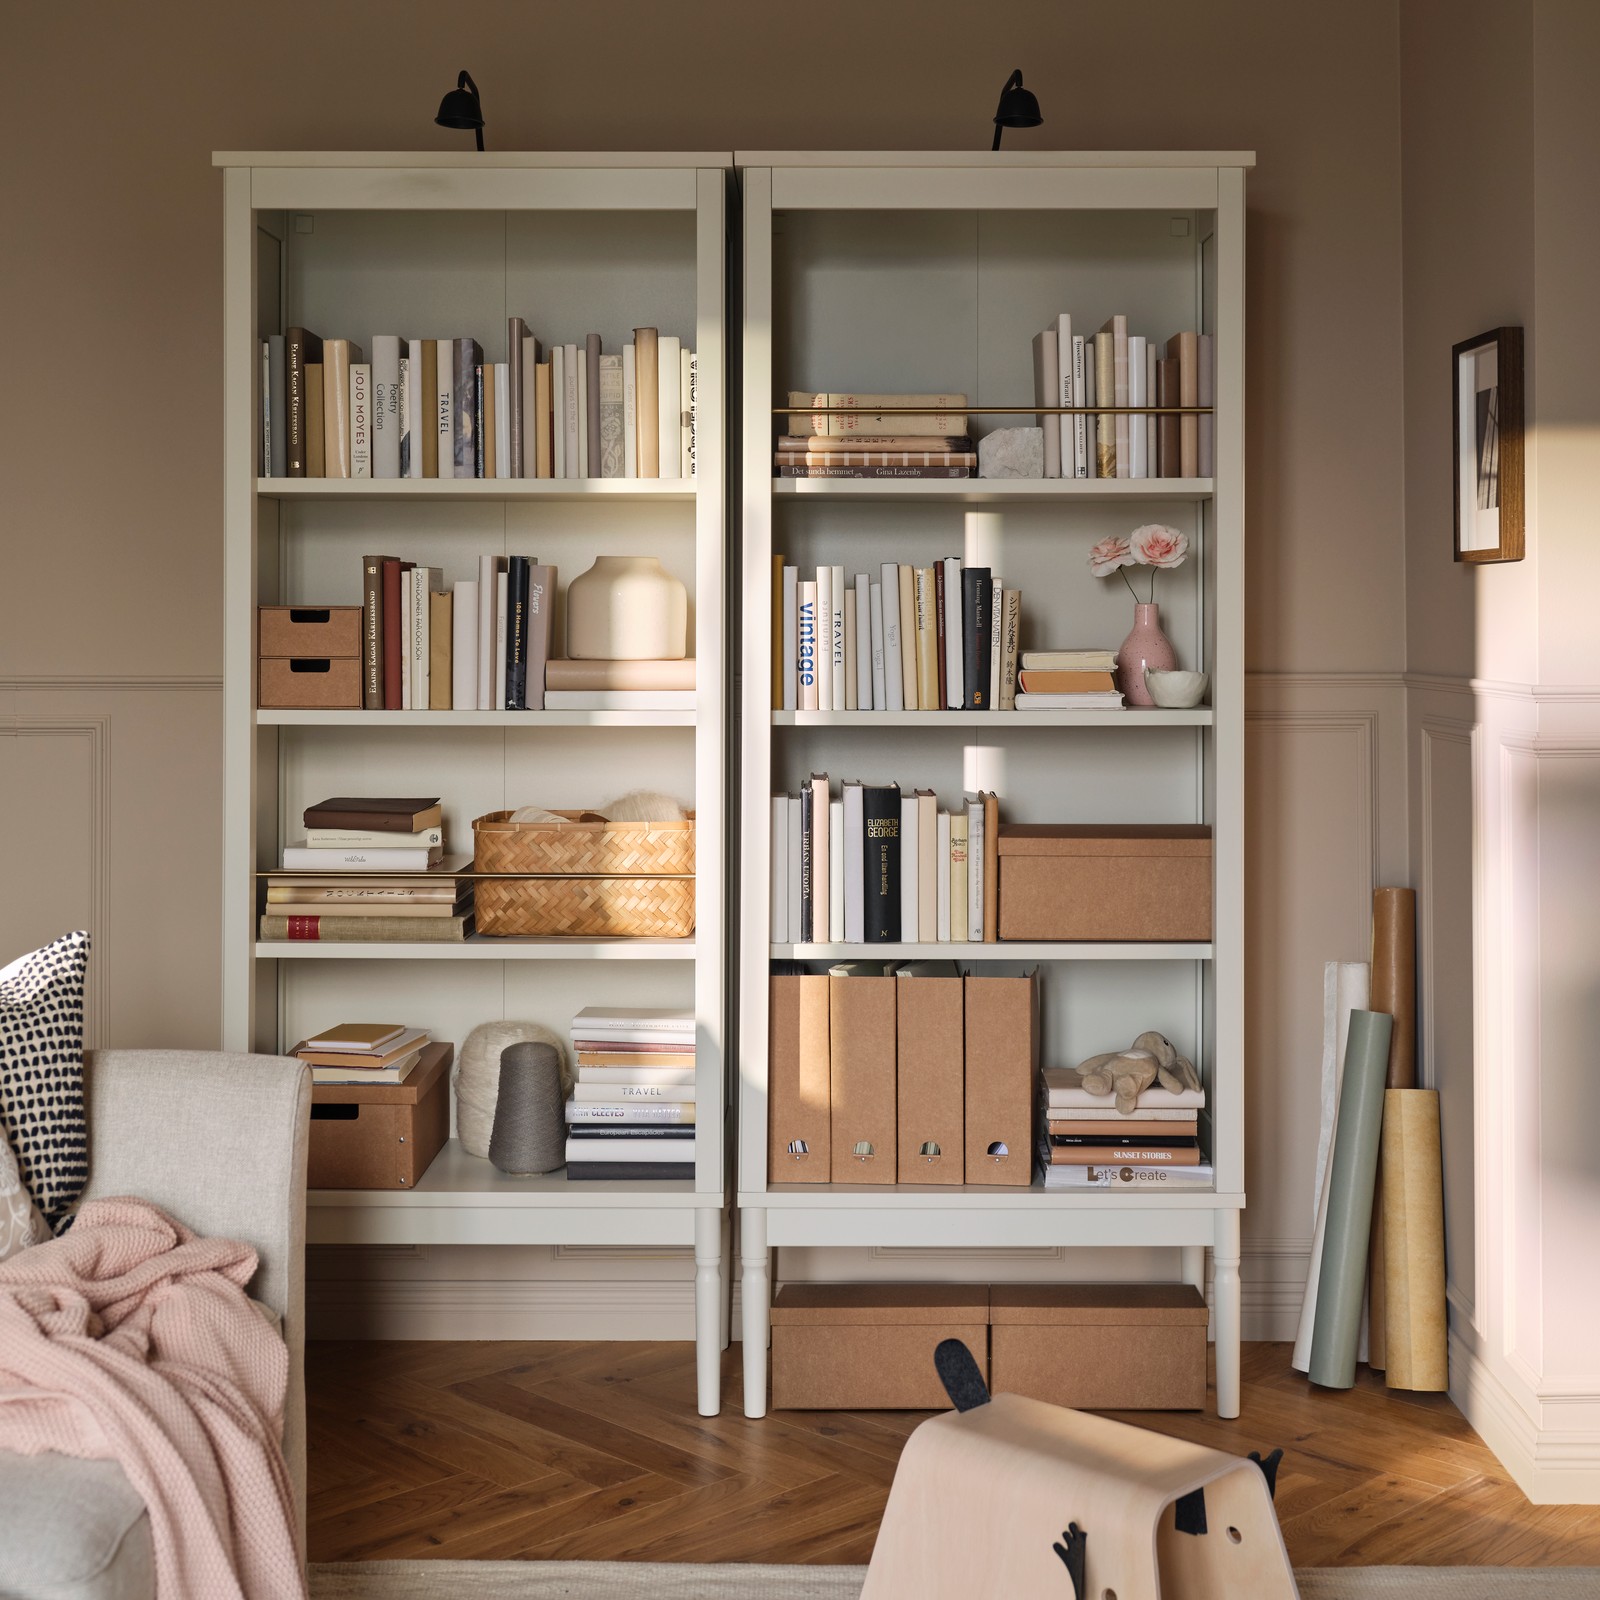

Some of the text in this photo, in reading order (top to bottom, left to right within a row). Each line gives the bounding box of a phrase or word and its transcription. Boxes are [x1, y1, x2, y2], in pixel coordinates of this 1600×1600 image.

[291, 371, 299, 394] KAGAN
[568, 376, 576, 401] journeys
[355, 370, 365, 445] JOJO MOYES
[376, 383, 386, 430] Collection
[388, 383, 399, 414] Poetry
[440, 393, 449, 435] TRAVEL
[876, 468, 893, 476] Gina
[894, 468, 922, 477] Lazenby
[532, 583, 543, 614] Flowers
[993, 587, 1002, 604] DEN
[515, 638, 521, 647] To
[834, 610, 842, 667] TRAVEL
[887, 624, 897, 641] Yoga
[368, 641, 376, 666] KAGAN
[797, 602, 816, 686] vintage
[874, 648, 884, 666] Yoga
[369, 667, 377, 693] ELAINE
[867, 818, 899, 827] ELIZABETH
[867, 826, 899, 838] GEORGE
[622, 1087, 662, 1096] TRAVEL
[591, 1107, 625, 1117] CLEEVES
[1113, 1151, 1172, 1159] SUNSET STORIES
[1087, 1166, 1167, 1183] Let's Create
